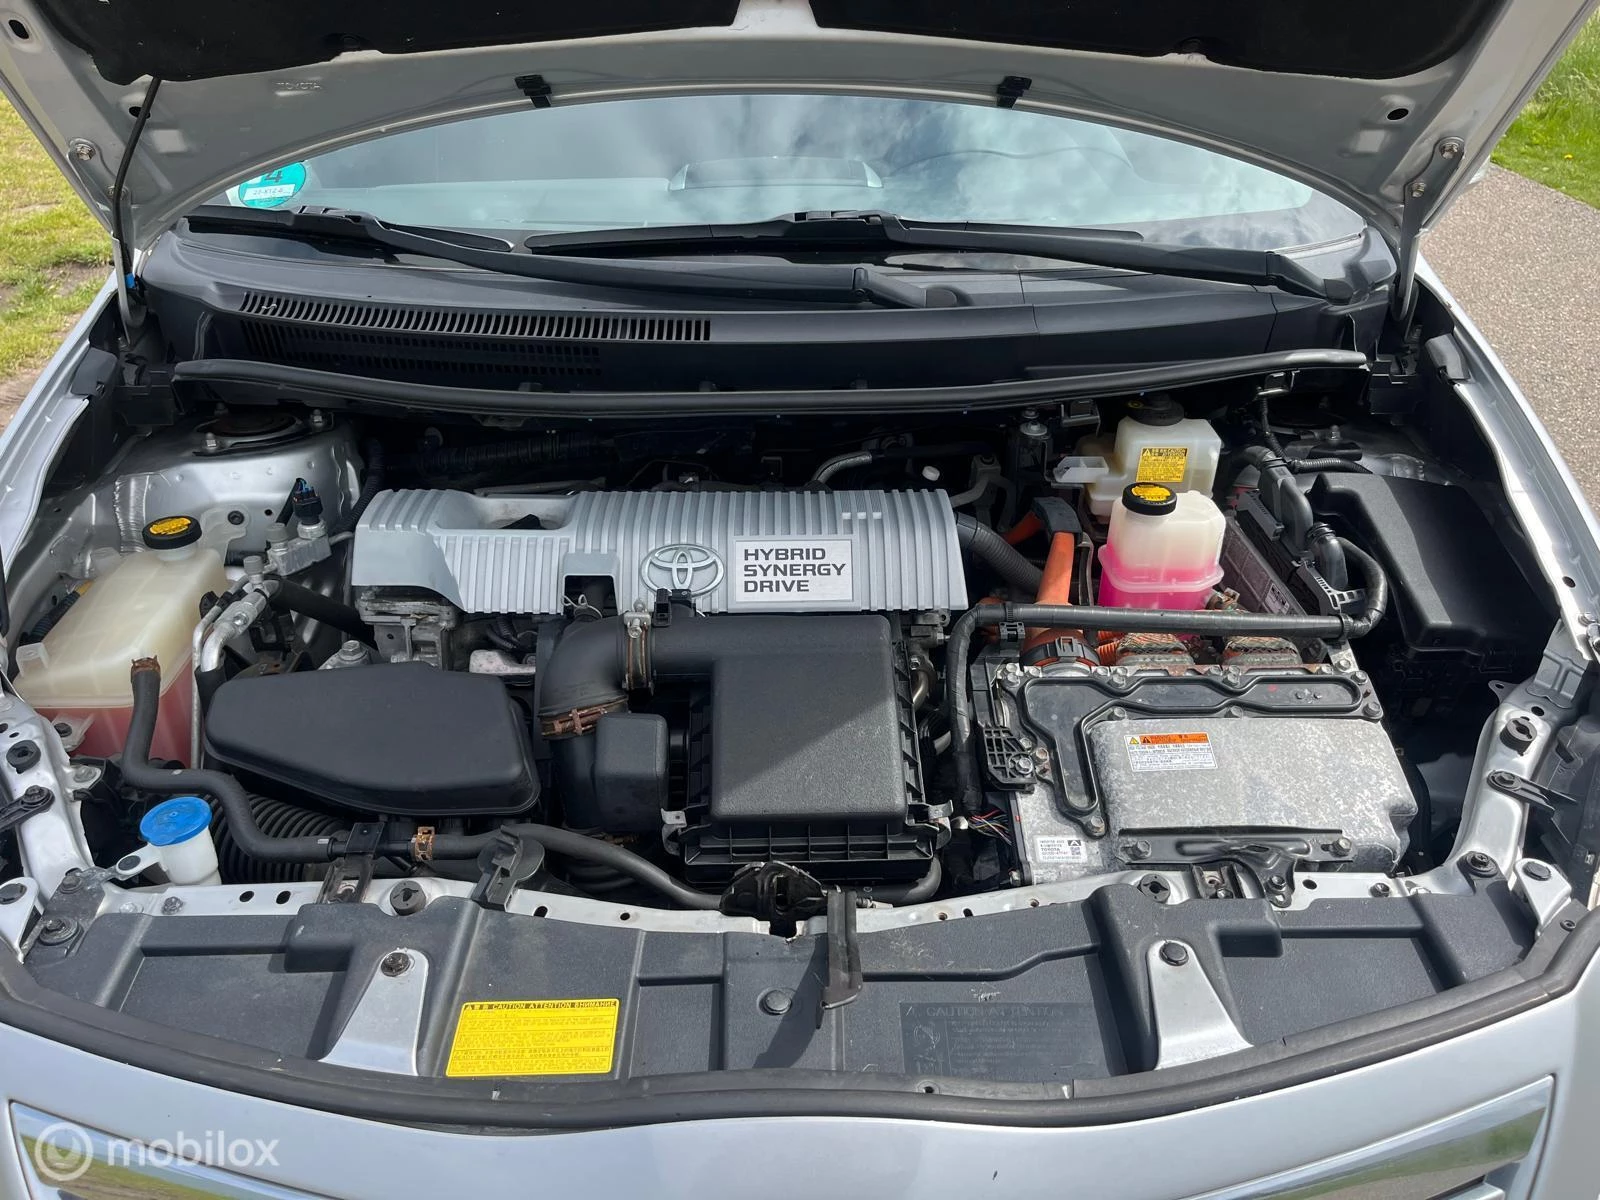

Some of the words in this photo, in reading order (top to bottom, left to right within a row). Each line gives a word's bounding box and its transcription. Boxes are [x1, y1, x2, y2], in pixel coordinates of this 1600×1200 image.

[744, 548, 826, 560] HYBRID
[744, 563, 846, 576] SYNERGY
[744, 580, 809, 592] DRIVE
[530, 1001, 572, 1009] ATTENTION
